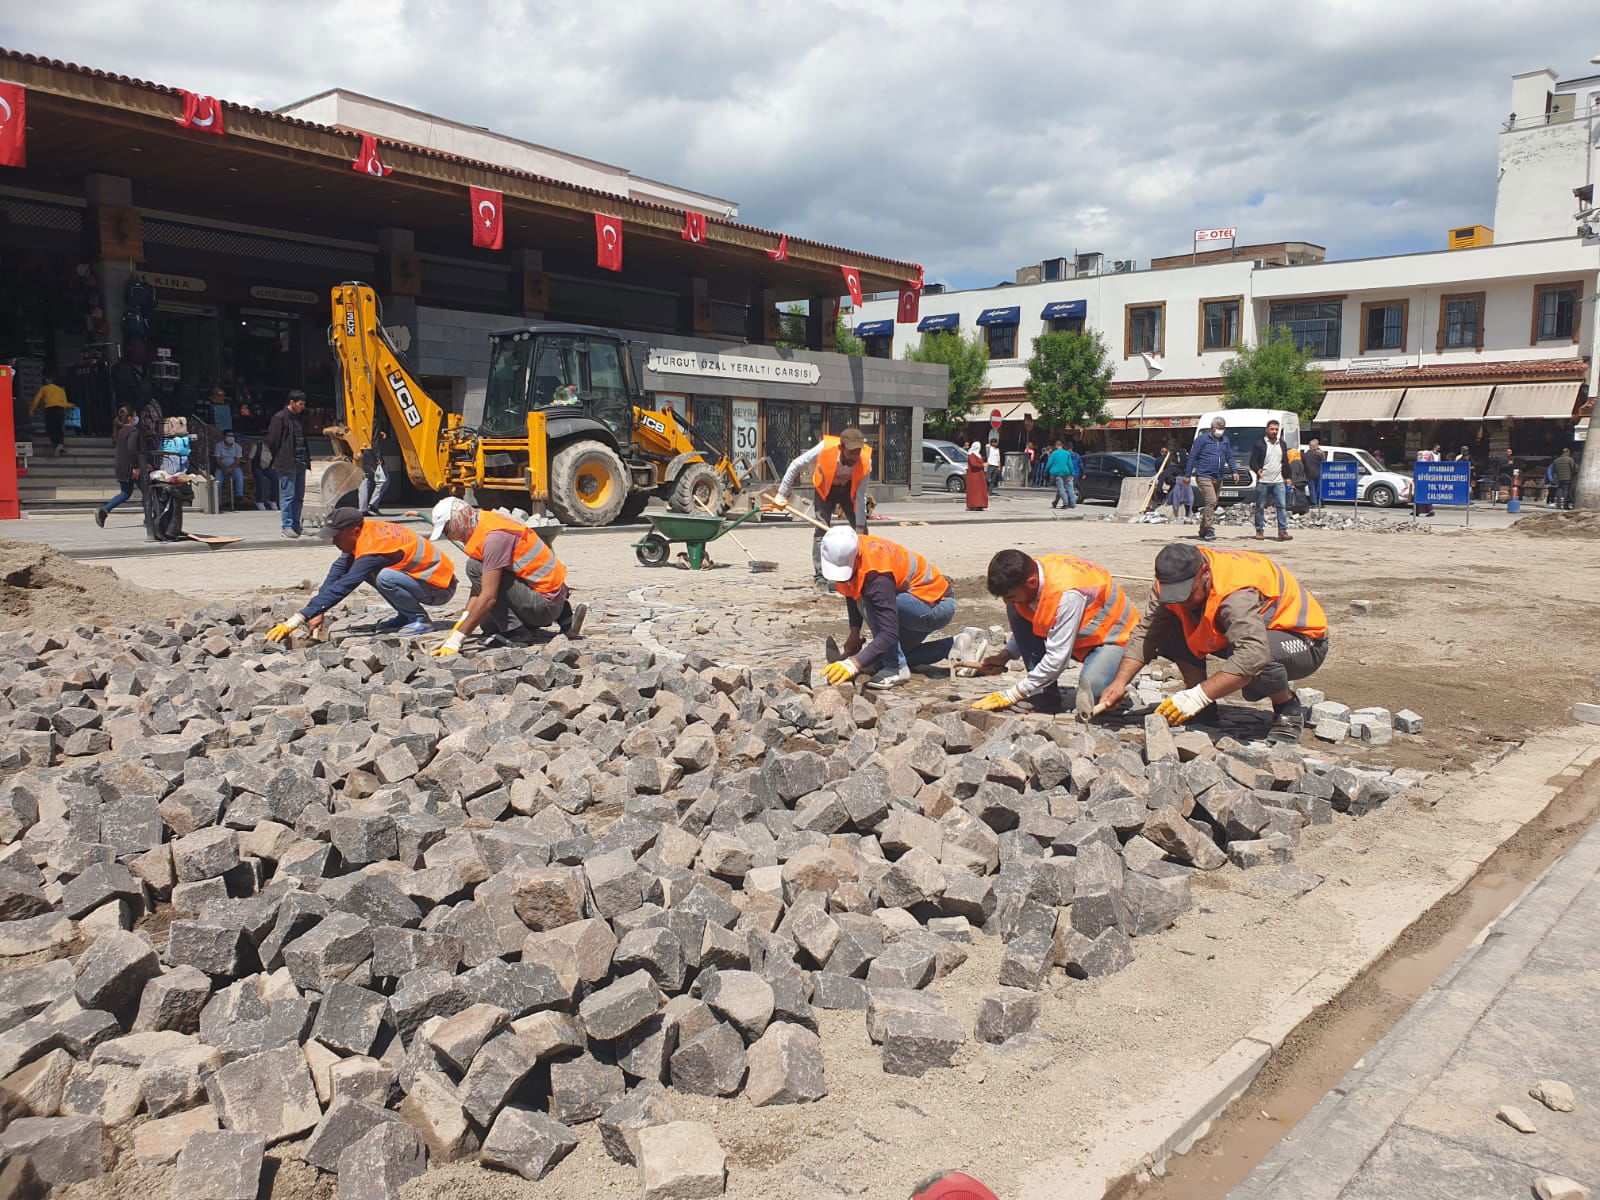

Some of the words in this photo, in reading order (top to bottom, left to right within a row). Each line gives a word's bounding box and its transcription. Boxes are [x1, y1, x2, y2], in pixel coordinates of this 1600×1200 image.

[1210, 229, 1233, 239] OTEL
[346, 311, 356, 336] 3CX
[656, 355, 696, 368] TURGUT
[701, 357, 727, 371] ÖZAL
[730, 362, 770, 375] YERALTI
[775, 366, 812, 379] ÇARŞISI
[388, 372, 422, 428] JCB
[640, 414, 666, 435] JCB
[737, 426, 757, 449] 50
